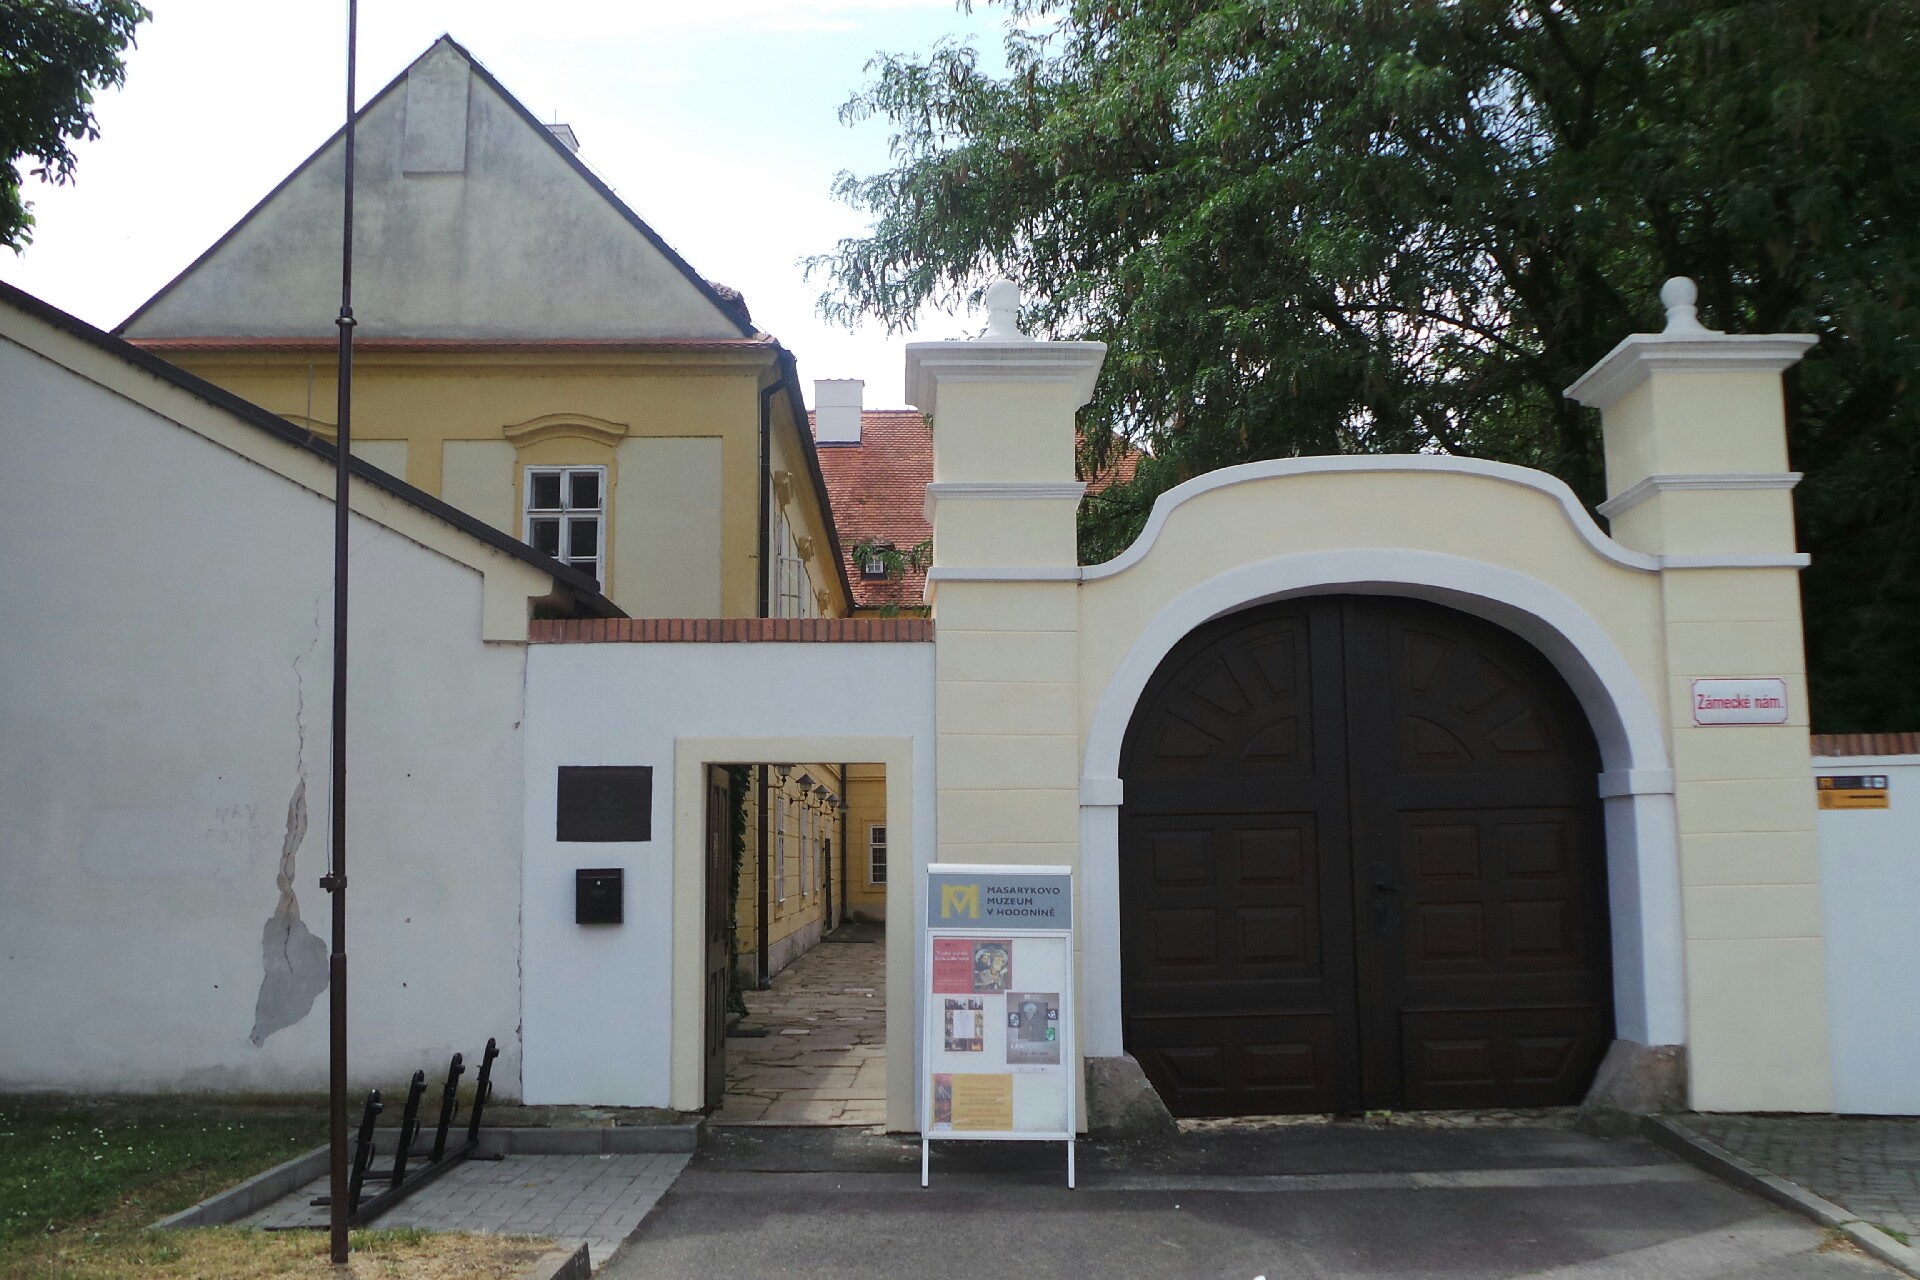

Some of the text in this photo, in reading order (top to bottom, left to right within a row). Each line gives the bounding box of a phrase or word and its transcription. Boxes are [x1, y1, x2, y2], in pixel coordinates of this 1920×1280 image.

[1697, 693, 1784, 710] Zámecké nám.
[986, 886, 1060, 895] MASARYKOVO
[986, 897, 1033, 906] MUZEUM
[986, 907, 1056, 917] V HODONÍNĚ
